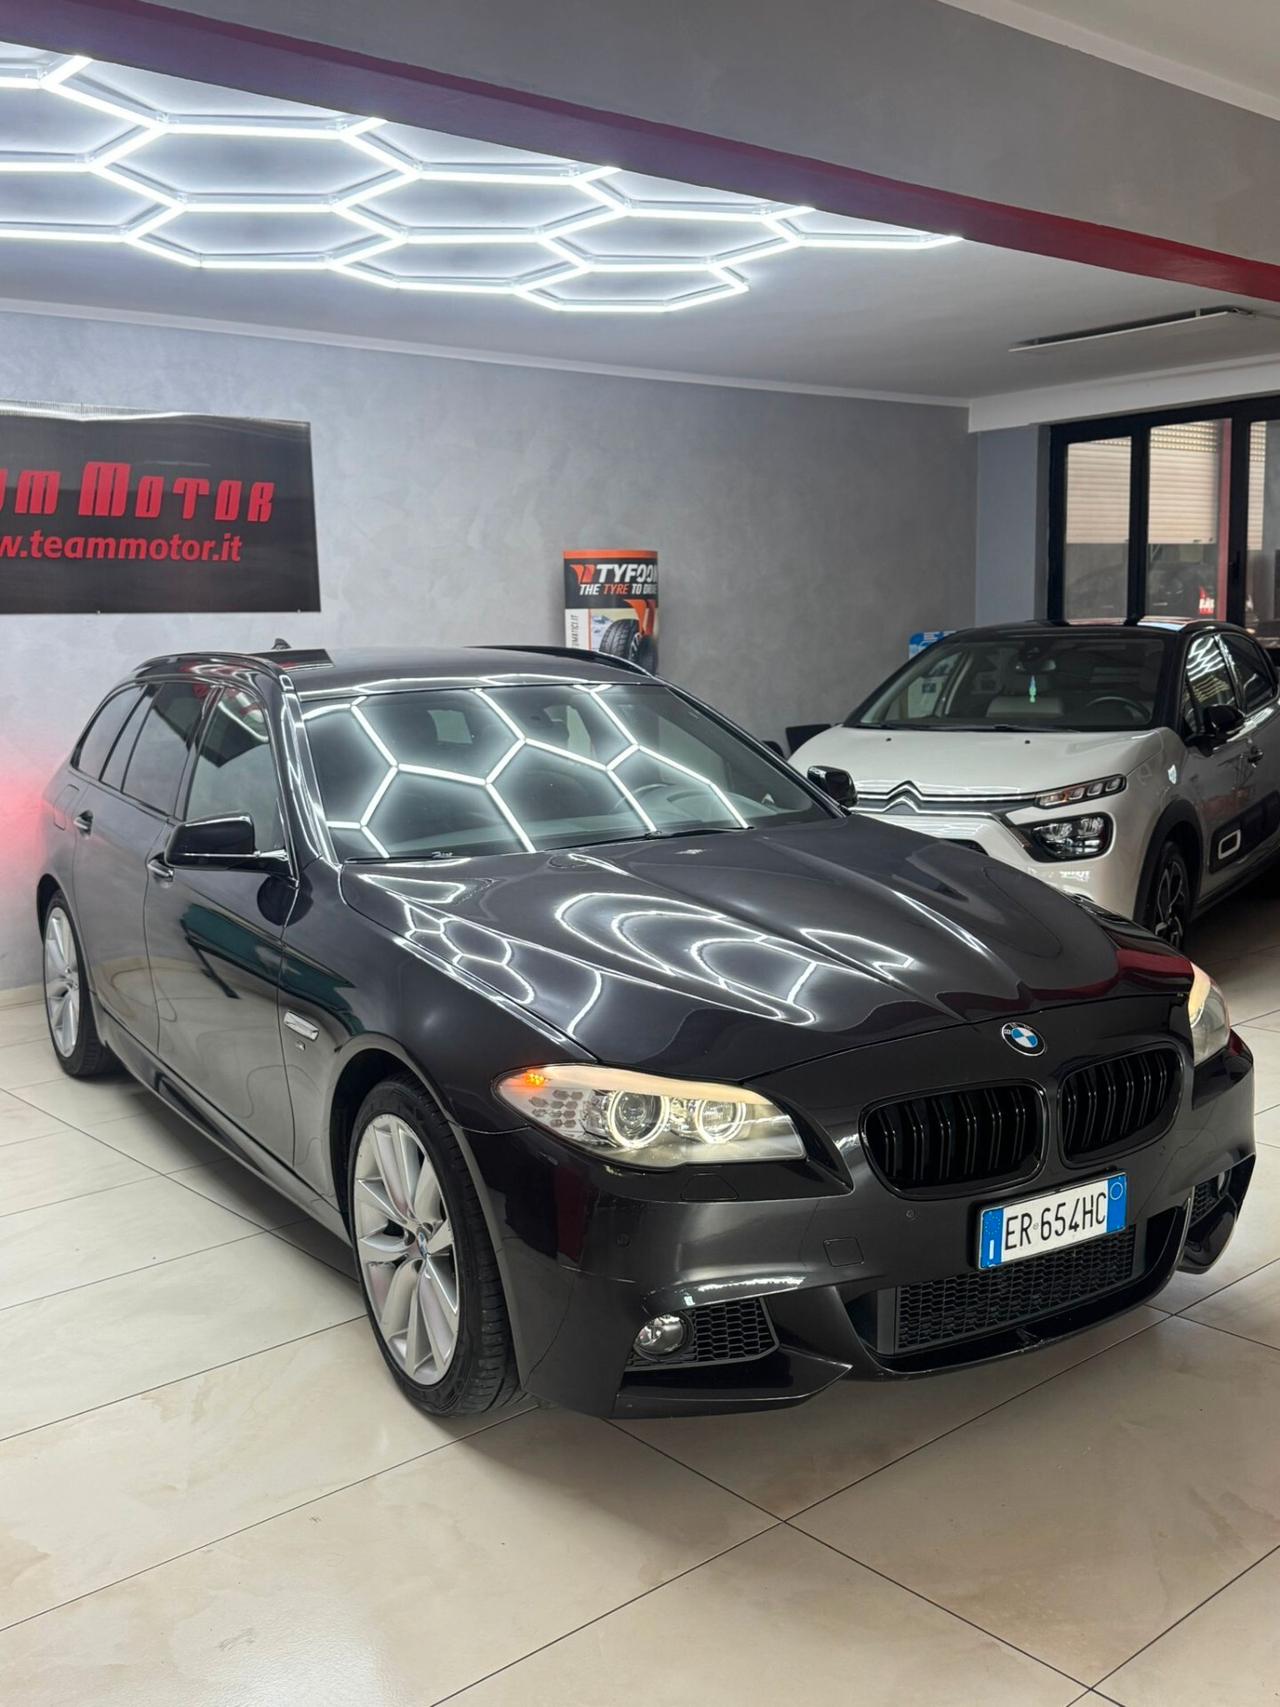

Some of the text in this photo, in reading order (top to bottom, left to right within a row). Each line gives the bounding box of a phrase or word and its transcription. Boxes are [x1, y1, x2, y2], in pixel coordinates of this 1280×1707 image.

[579, 584, 601, 595] THE
[603, 583, 629, 595] TYRE
[631, 583, 642, 595] TO
[1004, 1212, 1033, 1250] ER
[1040, 1192, 1107, 1241] 654HC
